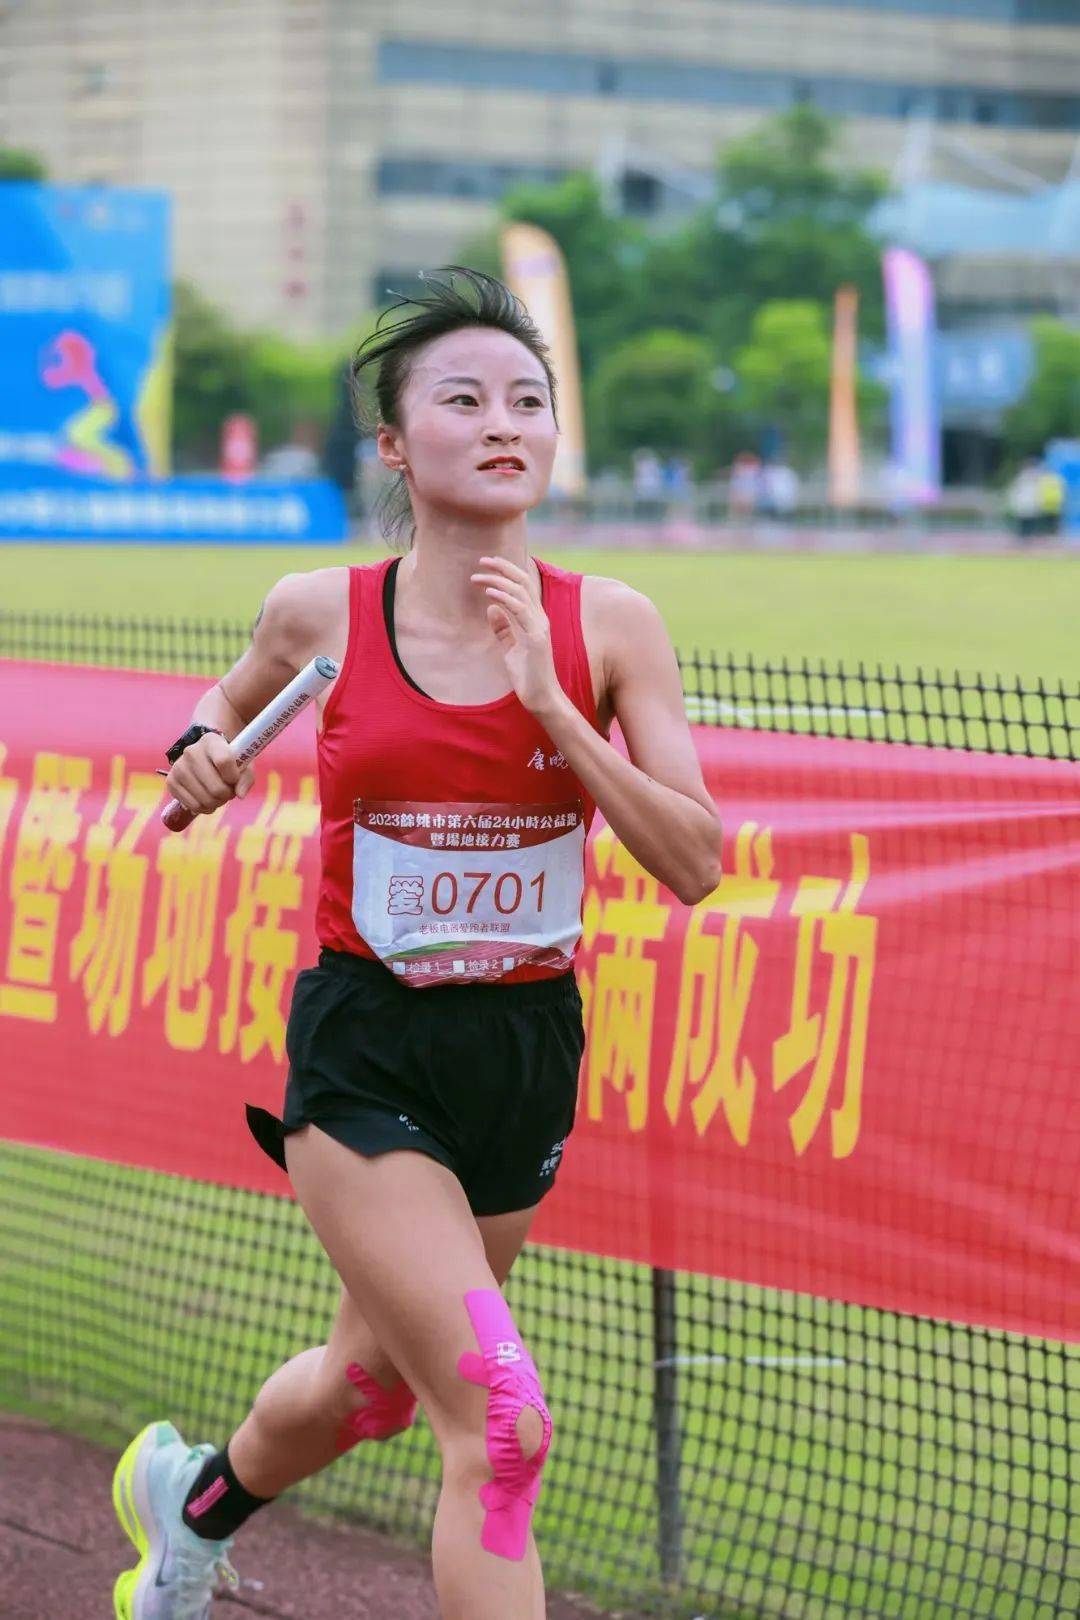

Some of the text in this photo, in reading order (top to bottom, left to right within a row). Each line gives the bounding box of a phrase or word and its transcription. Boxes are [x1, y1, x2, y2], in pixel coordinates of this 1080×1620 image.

[0, 741, 878, 1160] 暨场地接 满成功
[431, 871, 546, 916] 0701
